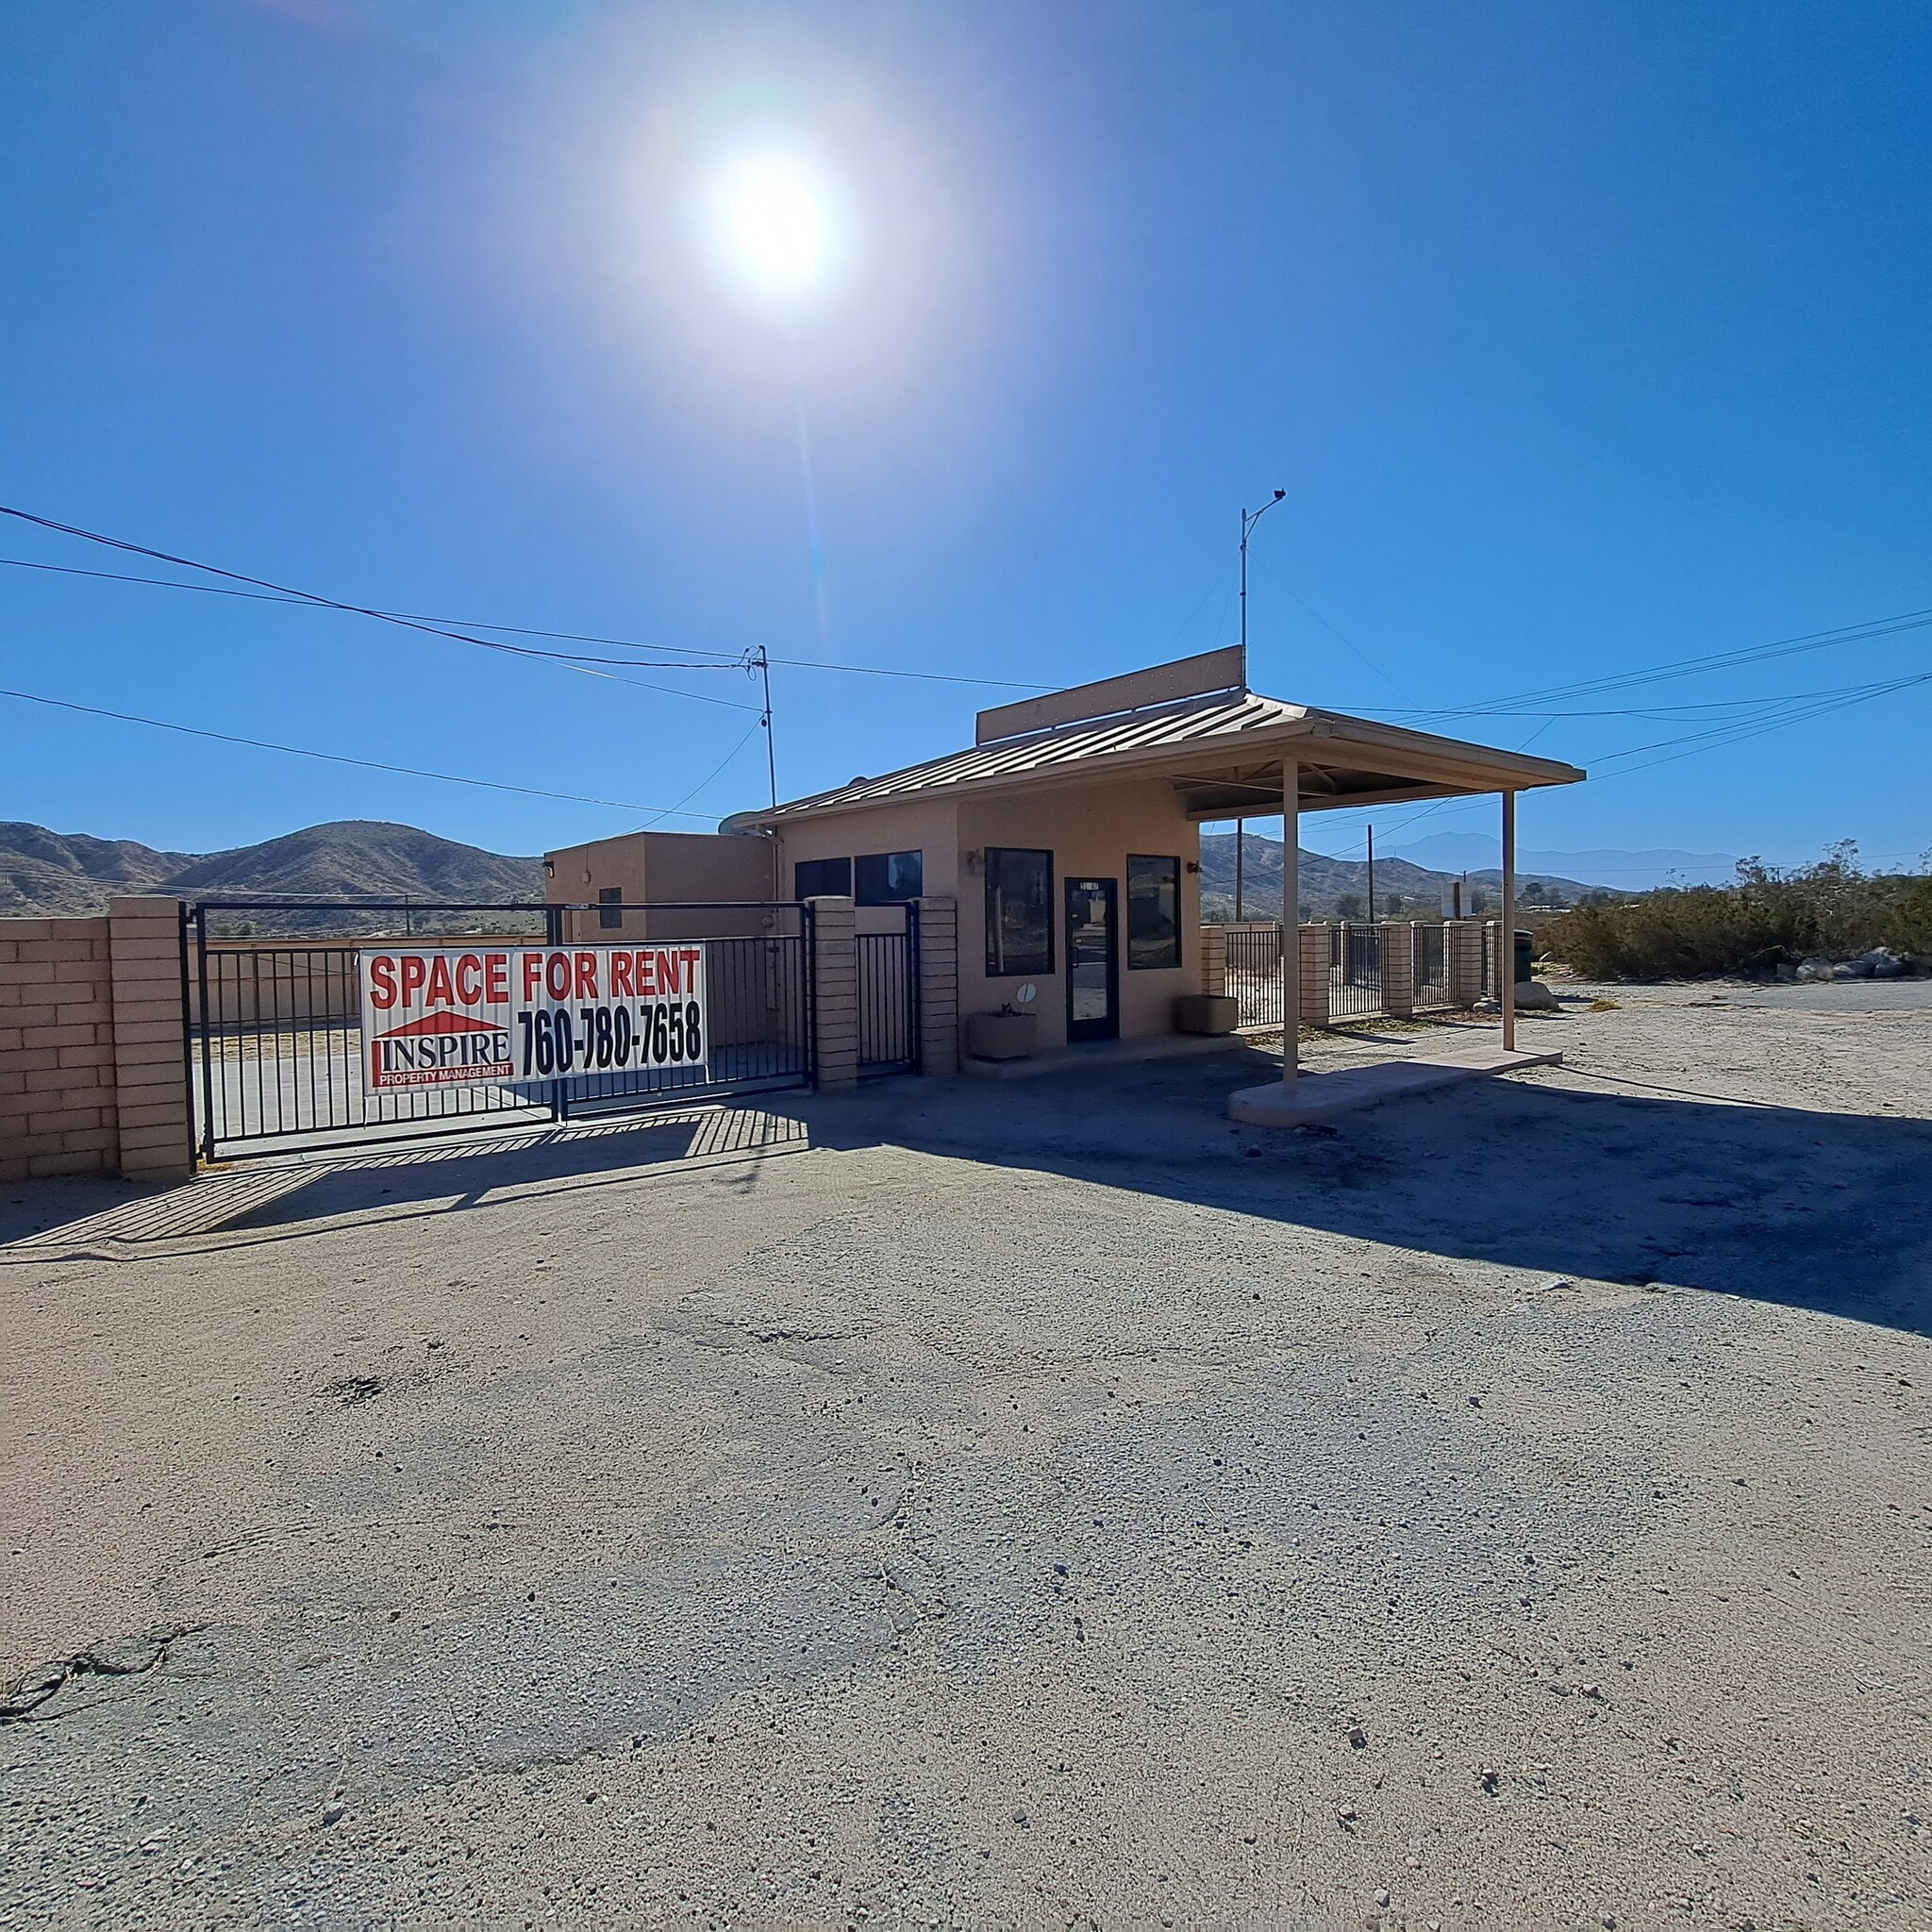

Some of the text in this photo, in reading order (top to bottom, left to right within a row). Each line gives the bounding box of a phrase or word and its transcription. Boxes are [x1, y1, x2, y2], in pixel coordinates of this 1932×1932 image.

[370, 950, 700, 1009] SPACE FOR RENT
[382, 1032, 510, 1072] INSPIRE
[518, 1000, 701, 1076] 760-780-7658
[380, 1065, 510, 1085] PROPERTY MANAGEMENT
